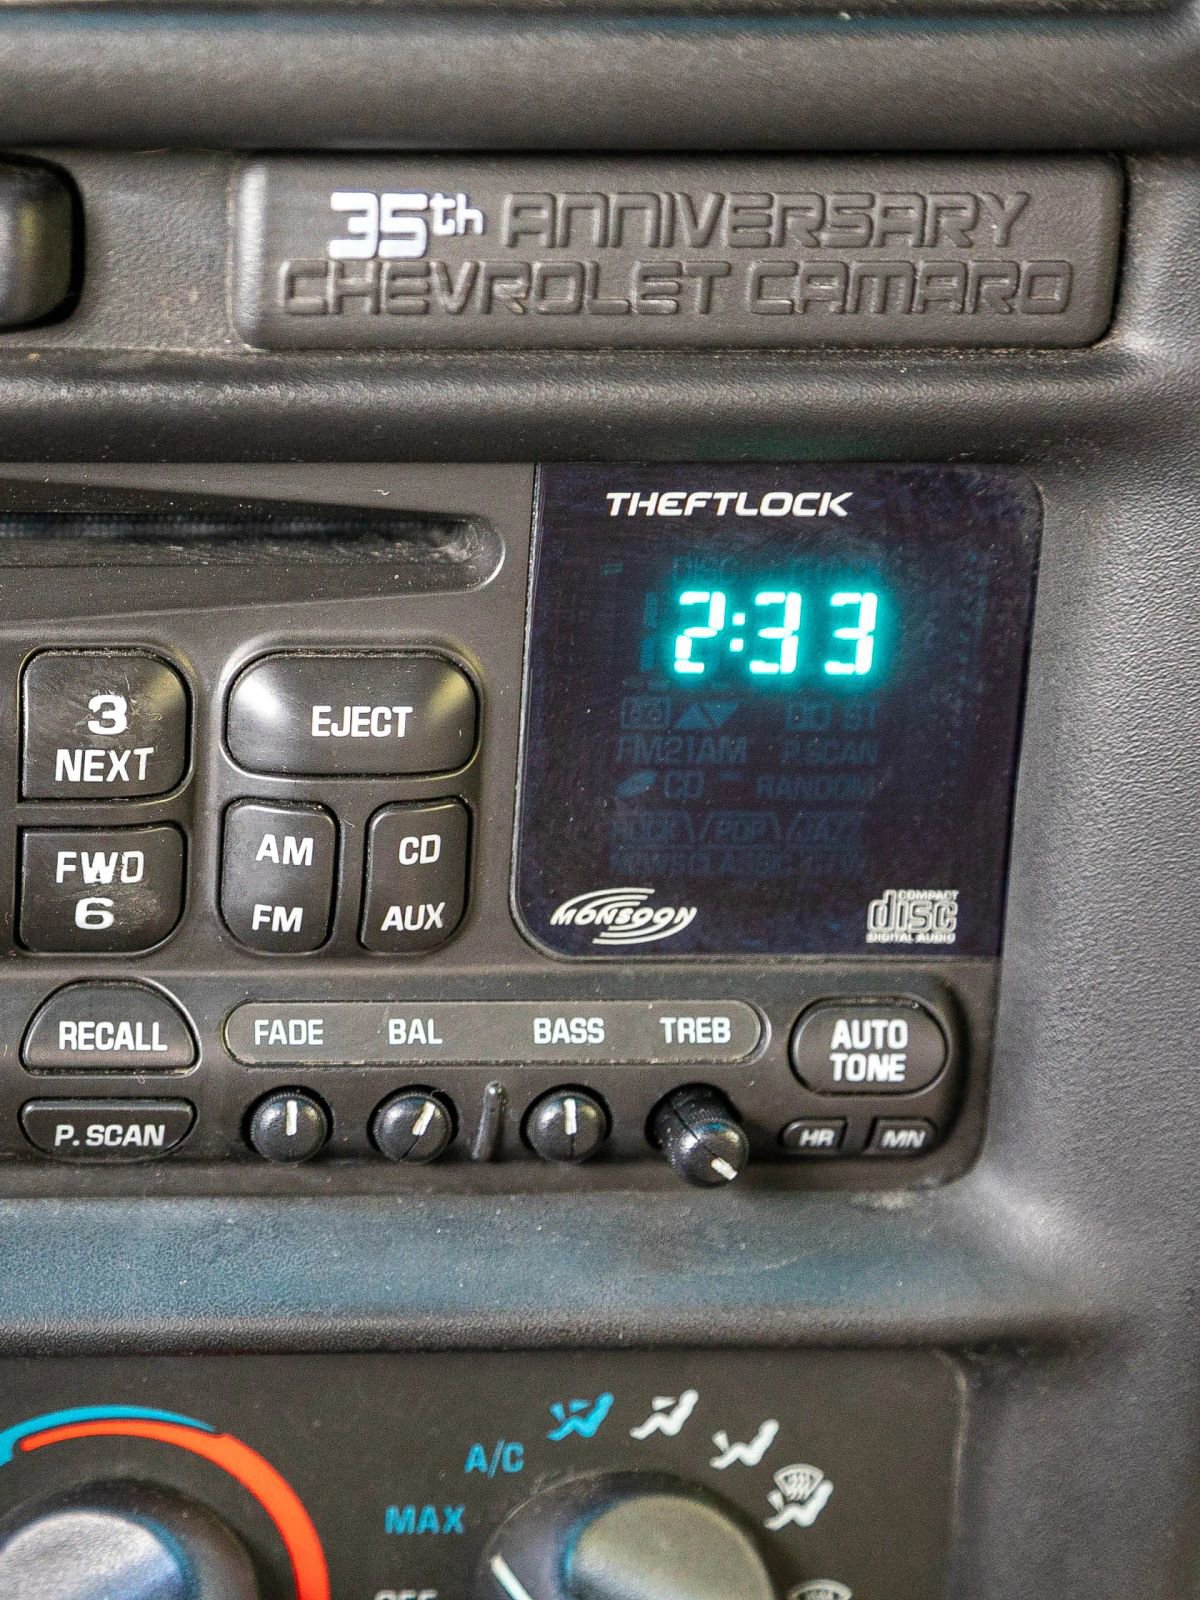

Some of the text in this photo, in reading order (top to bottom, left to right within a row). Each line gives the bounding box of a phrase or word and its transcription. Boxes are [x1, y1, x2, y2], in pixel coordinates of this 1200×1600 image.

[328, 191, 1031, 261] 35th ANNIVERSARY
[278, 258, 1073, 315] CHEVROLET CAMARO
[606, 491, 853, 517] THEFTLOCK
[674, 591, 878, 675] 2:33
[87, 694, 129, 735] 3
[311, 705, 413, 738] EJECT
[55, 747, 154, 782] NEXT
[255, 833, 314, 866] AM
[398, 834, 441, 866] CD
[56, 850, 144, 884] FWD
[898, 890, 959, 900] COMPACT
[75, 896, 115, 930] 6
[251, 903, 304, 933] FM
[380, 901, 446, 931] AUX
[550, 897, 698, 935] MONSOON
[866, 932, 956, 944] DIGITAL AUDIO
[59, 1021, 168, 1051] RECALL
[254, 1016, 731, 1046] FADE BAL BASS TREB
[831, 1019, 908, 1049] AUTO
[830, 1053, 906, 1081] TONE
[801, 1129, 835, 1145] HR
[883, 1130, 925, 1147] MN
[463, 1440, 525, 1478] A/C
[384, 1504, 465, 1534] MAX
